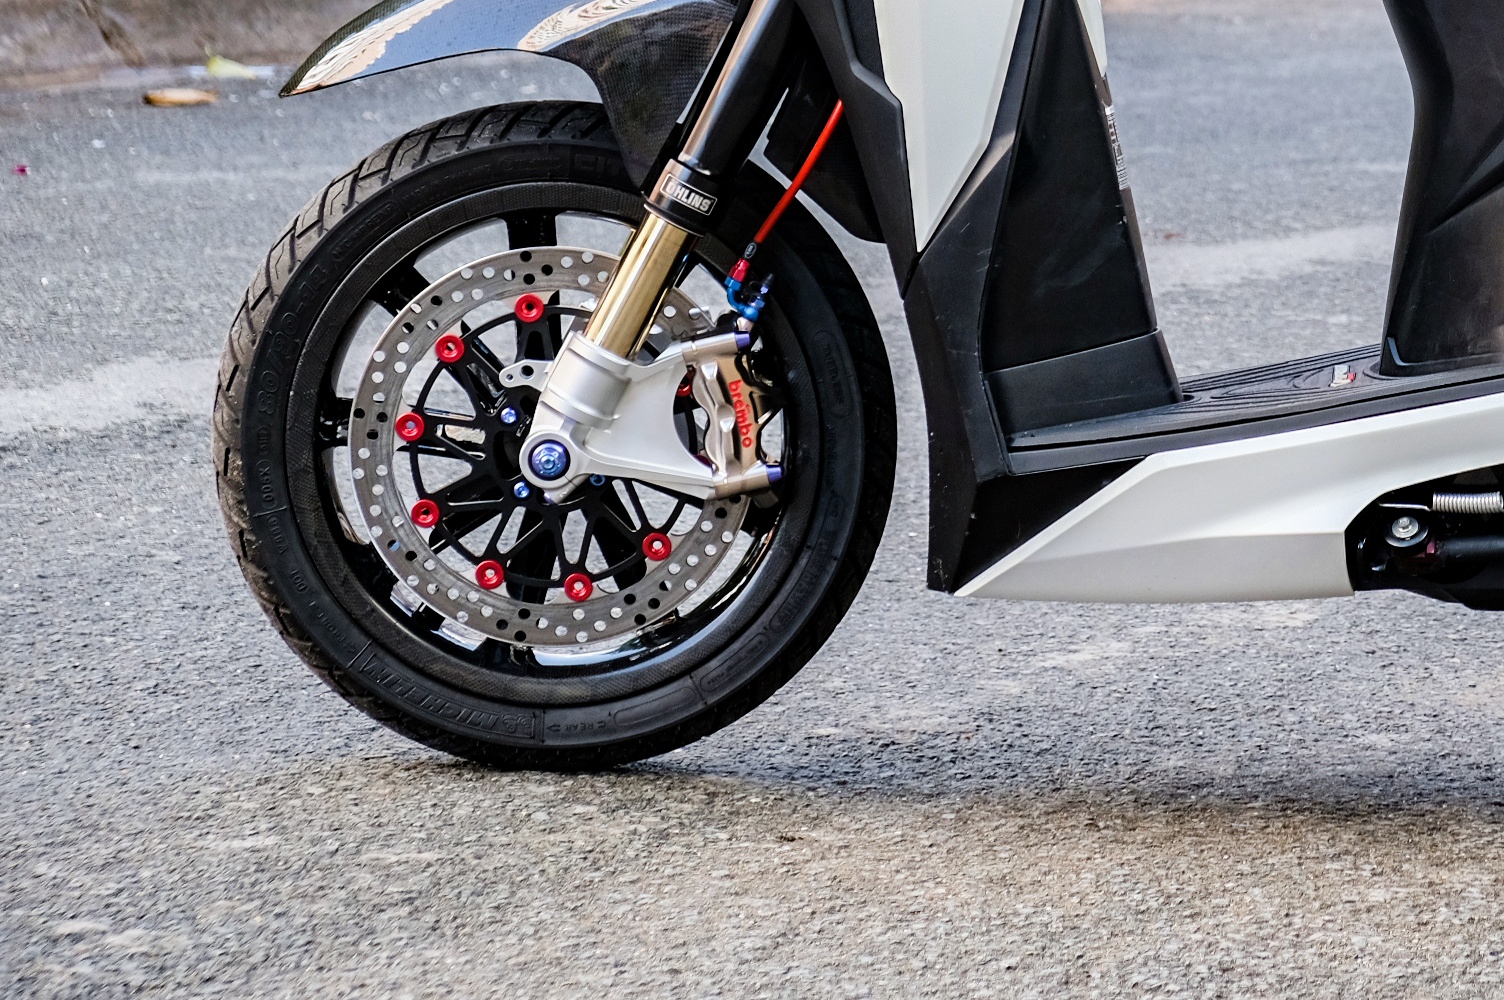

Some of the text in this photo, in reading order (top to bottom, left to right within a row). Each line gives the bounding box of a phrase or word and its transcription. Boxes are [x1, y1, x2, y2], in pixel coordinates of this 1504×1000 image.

[257, 263, 329, 415] 80/90-14
[728, 379, 753, 448] brembo
[359, 652, 499, 731] MICHELIN
